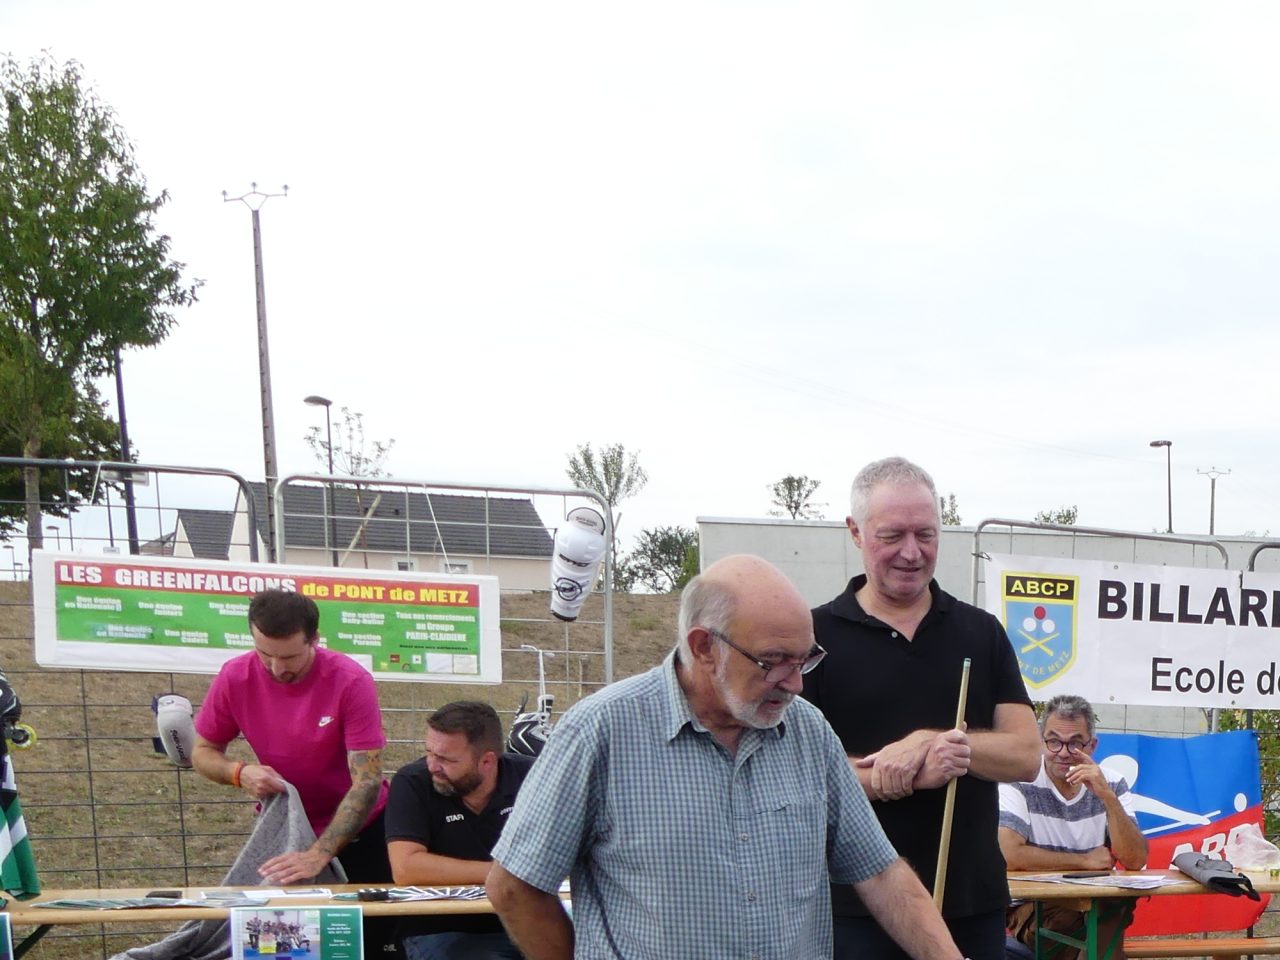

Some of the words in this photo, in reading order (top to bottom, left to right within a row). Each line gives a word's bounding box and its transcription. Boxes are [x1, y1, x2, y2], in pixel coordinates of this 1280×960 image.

[60, 565, 102, 583] LES
[115, 568, 297, 593] GREENFALCONS
[302, 583, 329, 597] de
[334, 584, 386, 599] PONT
[390, 588, 415, 601] de
[420, 589, 469, 604] METZ
[1010, 580, 1069, 596] ABCP
[1152, 657, 1246, 694] Ecole
